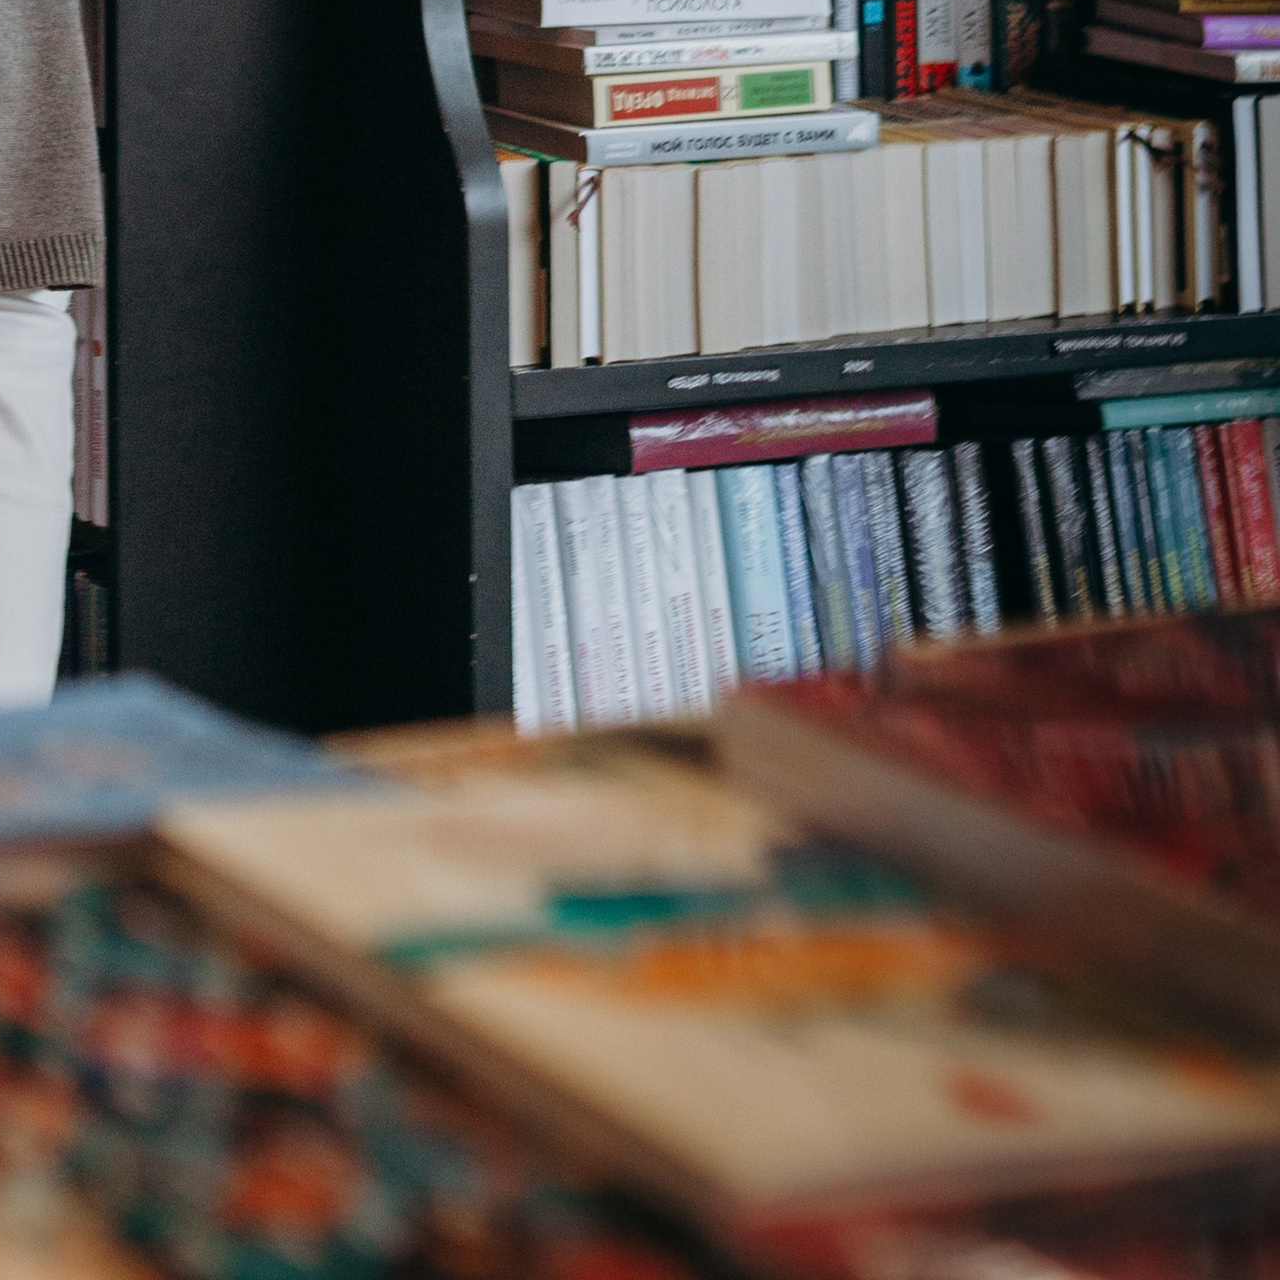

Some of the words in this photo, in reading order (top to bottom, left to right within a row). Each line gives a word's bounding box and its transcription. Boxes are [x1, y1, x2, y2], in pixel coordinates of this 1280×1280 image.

[612, 89, 666, 113] ФРЕЙД
[651, 136, 684, 155] МОЙ
[686, 133, 733, 152] ГОЛОС
[738, 132, 780, 150] БУДЕТ
[783, 131, 792, 145] С
[796, 128, 837, 144] ВАМИ
